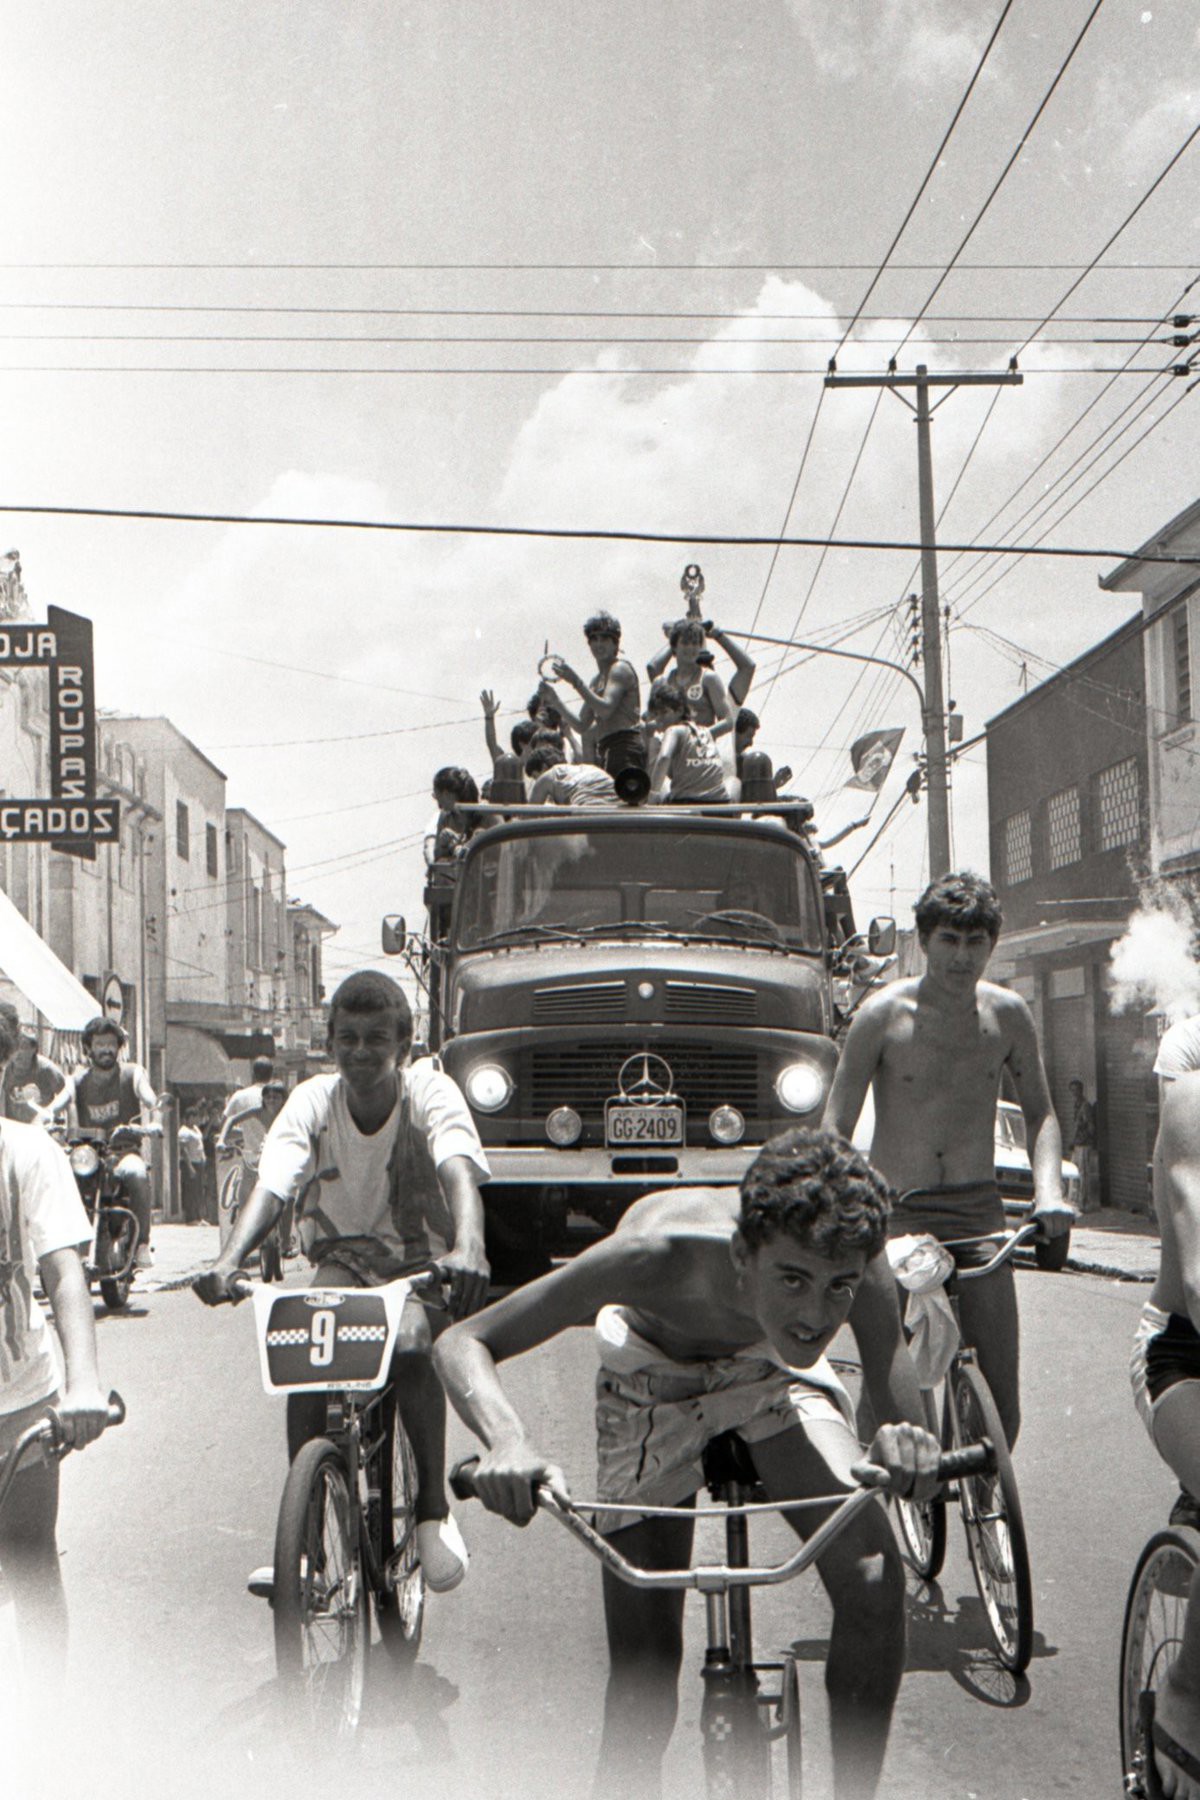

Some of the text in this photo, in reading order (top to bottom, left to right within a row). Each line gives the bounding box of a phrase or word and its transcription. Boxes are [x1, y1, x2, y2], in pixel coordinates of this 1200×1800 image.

[58, 666, 86, 799] ROUPAS
[1, 807, 113, 838] ÇADOS
[309, 1310, 336, 1367] 9
